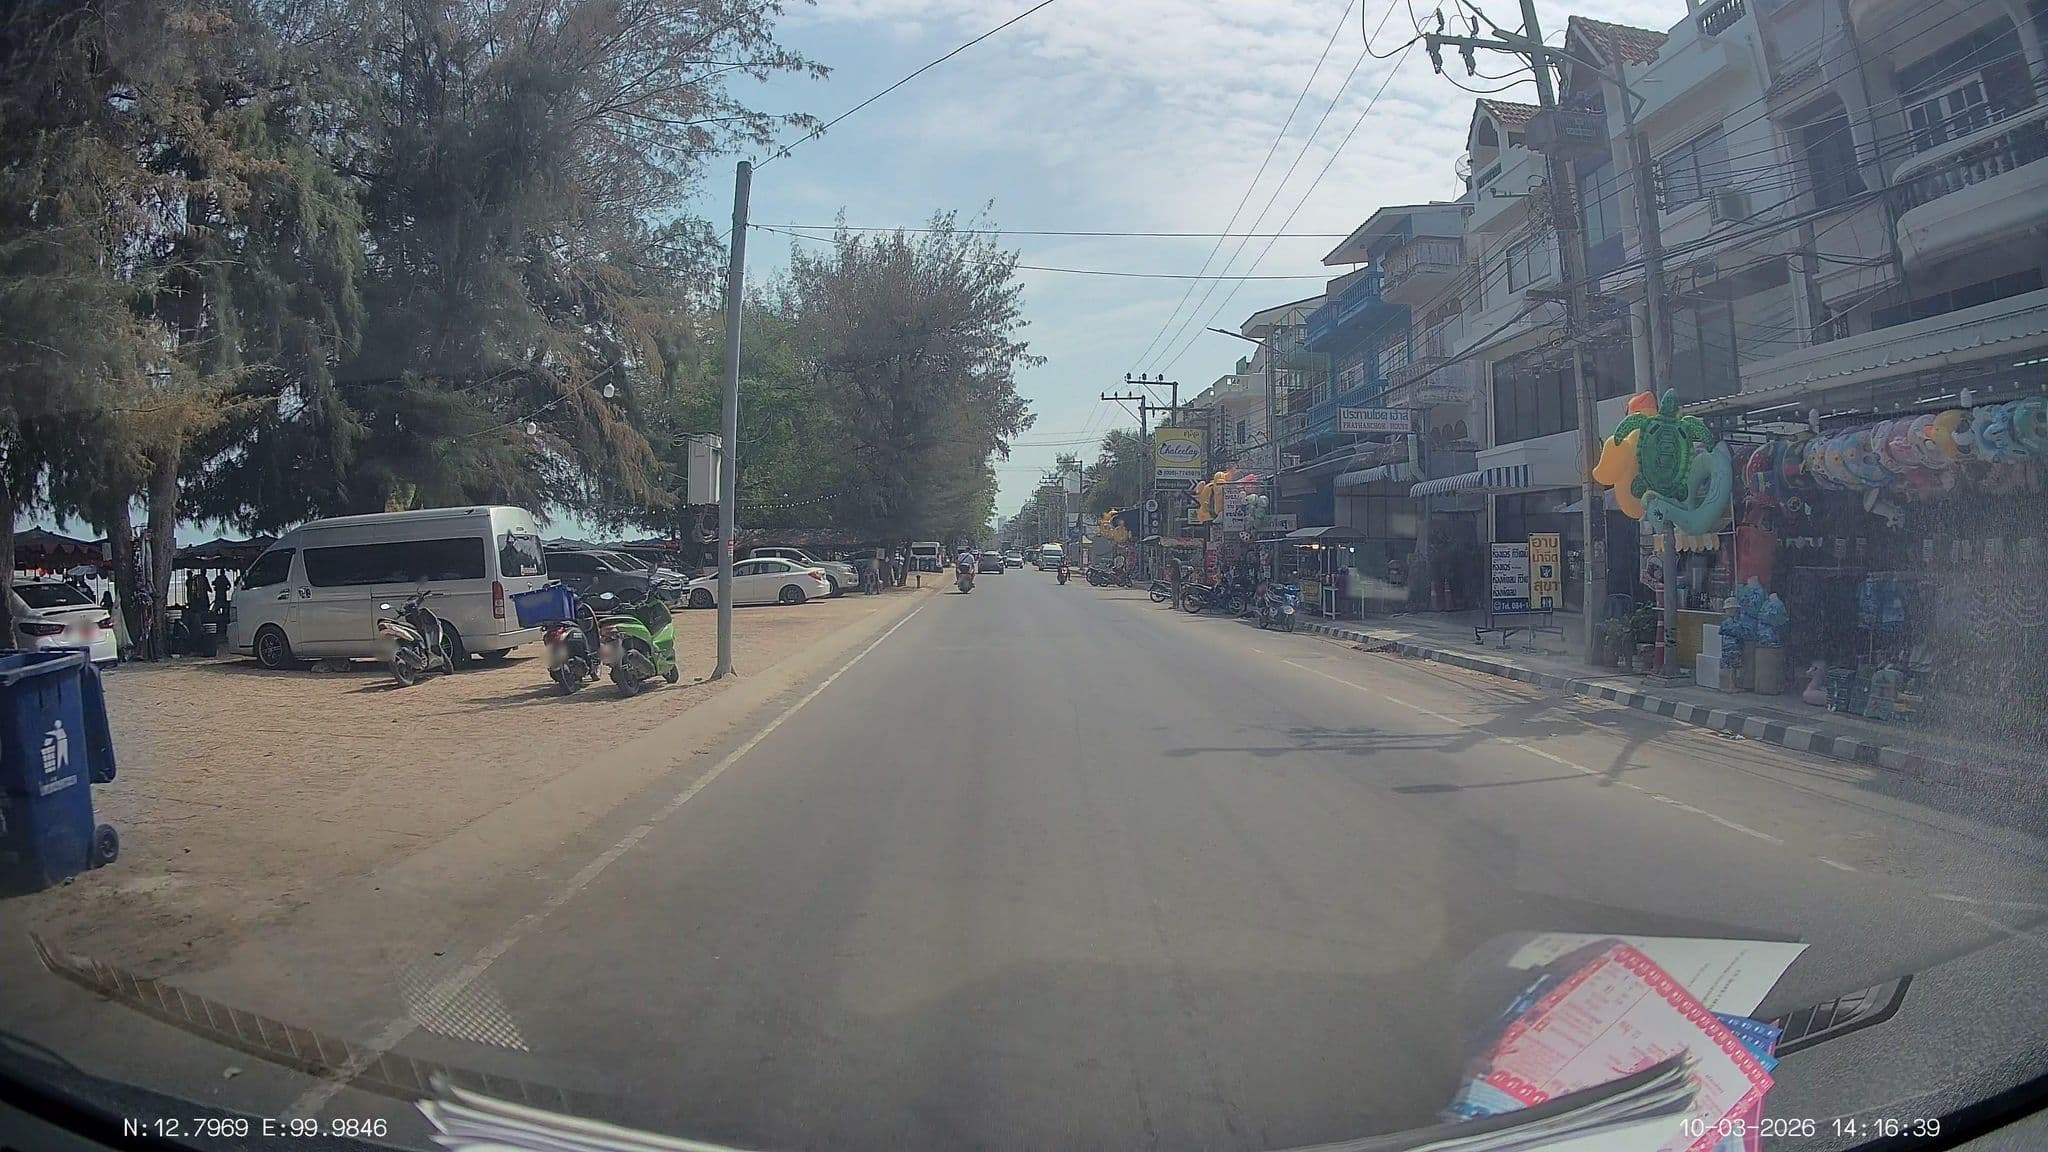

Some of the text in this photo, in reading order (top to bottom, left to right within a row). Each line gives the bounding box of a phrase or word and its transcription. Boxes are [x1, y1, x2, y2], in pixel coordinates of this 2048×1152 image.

[1532, 537, 1558, 548] อาบ
[1532, 550, 1558, 562] น้ำจืด
[1534, 580, 1559, 595] สุขา
